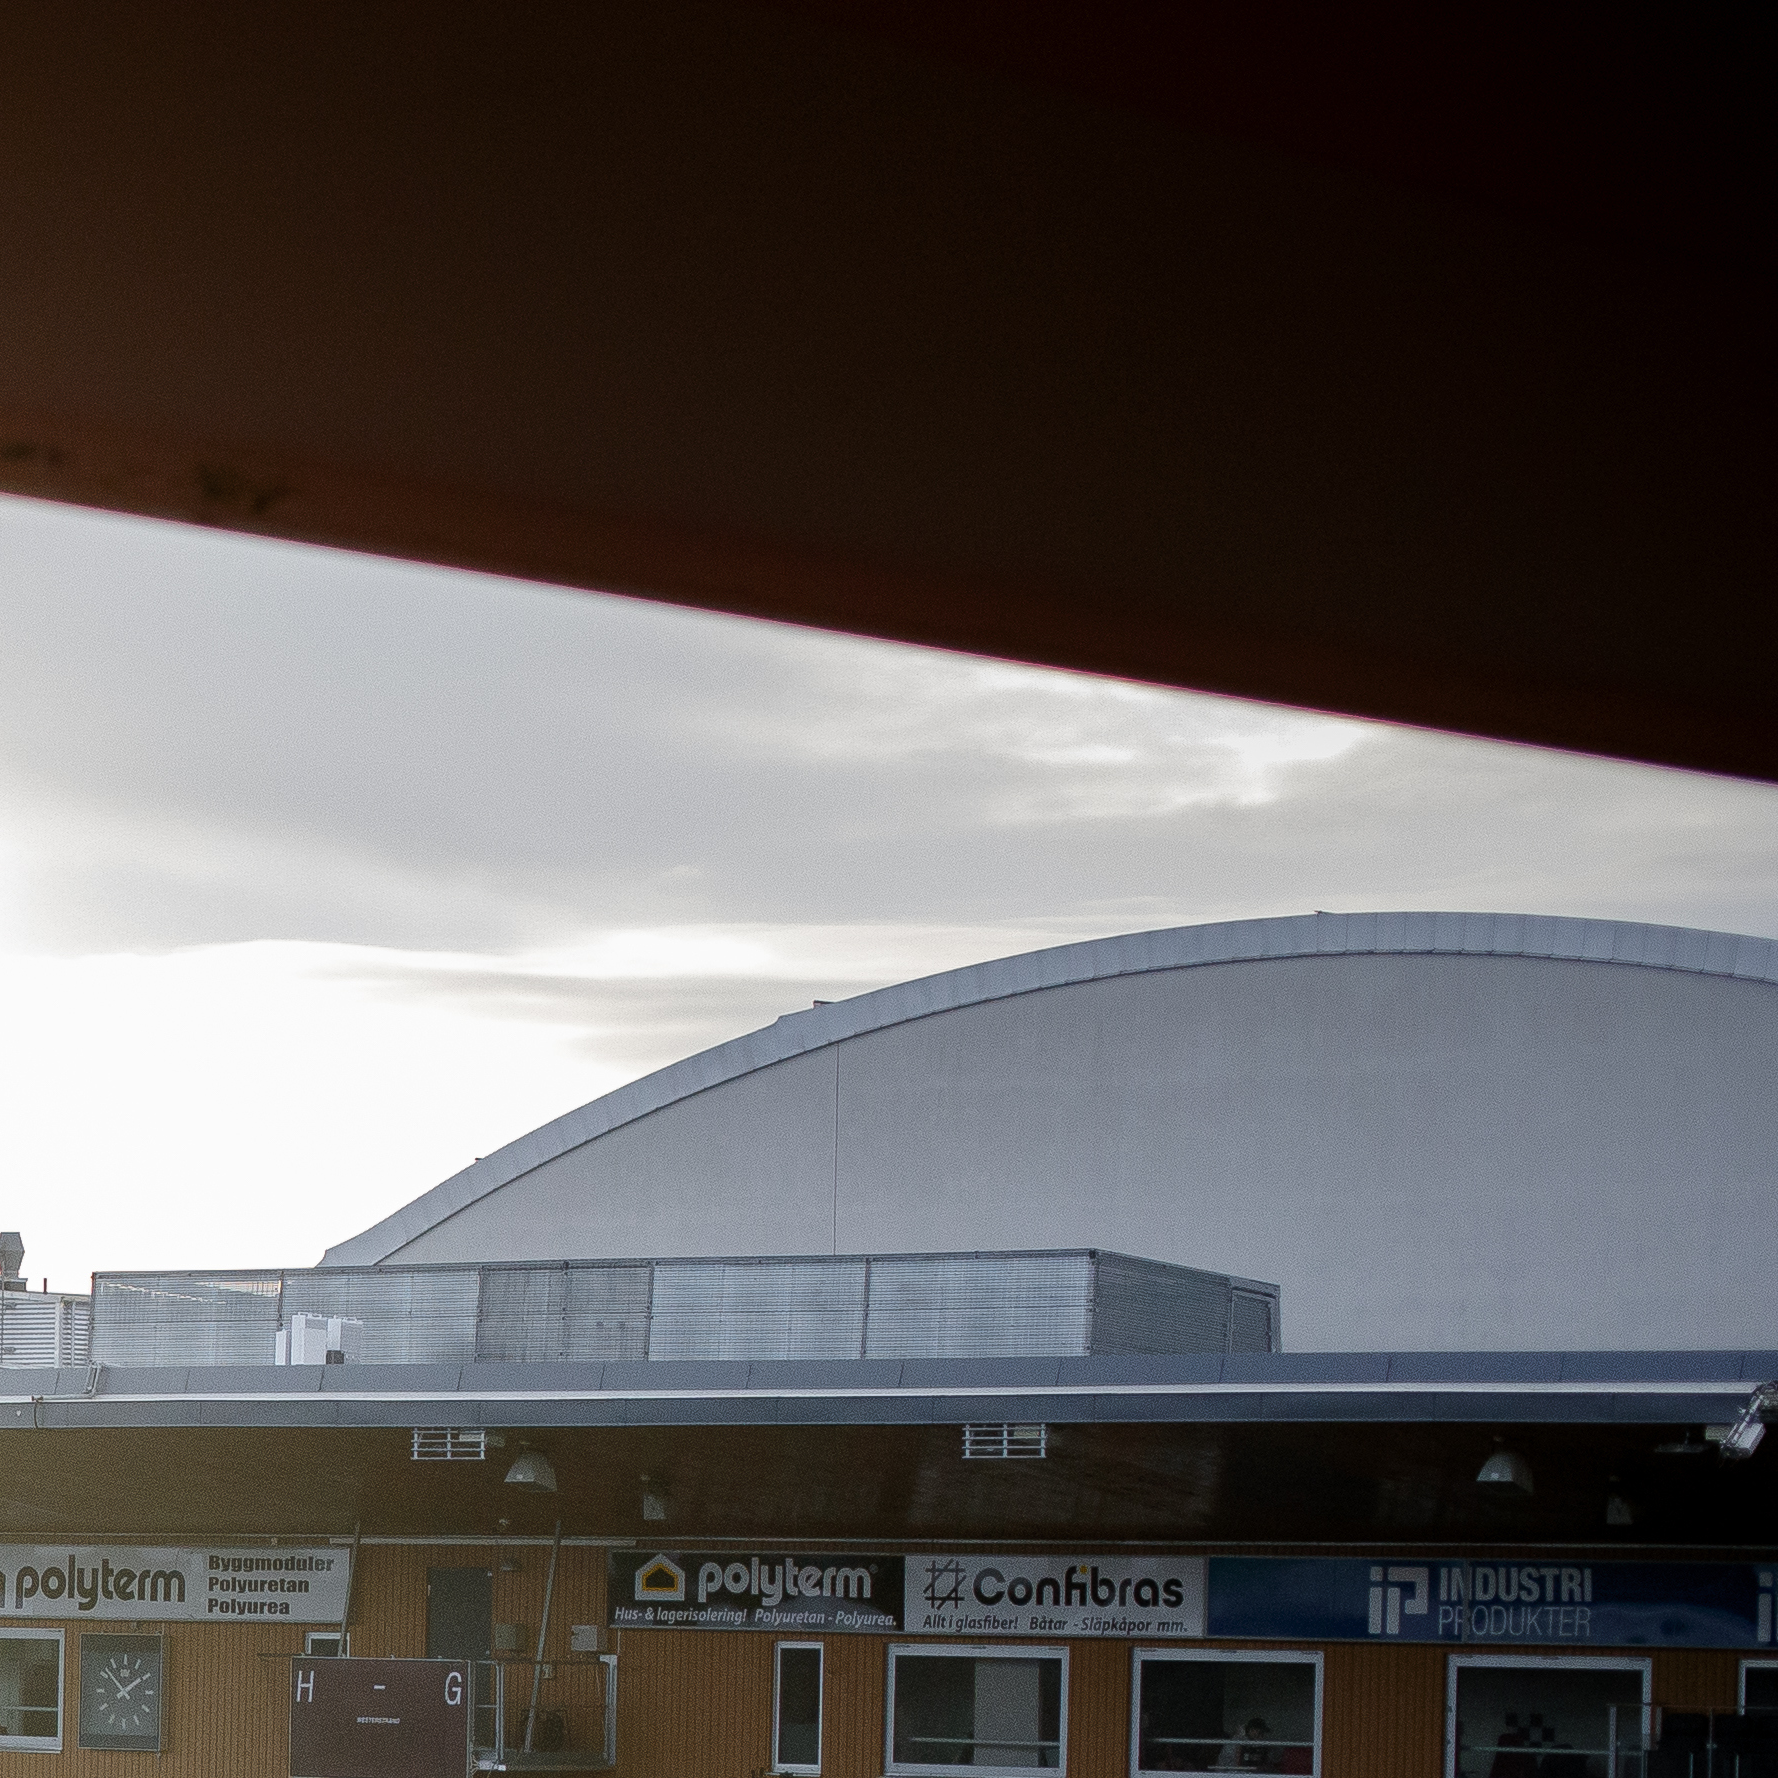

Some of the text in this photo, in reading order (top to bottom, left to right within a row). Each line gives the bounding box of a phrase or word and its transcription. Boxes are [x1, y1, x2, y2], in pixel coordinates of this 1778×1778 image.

[208, 1555, 335, 1573] Byggmoduler
[16, 1554, 185, 1611] polyterm
[208, 1577, 310, 1594] Polyuretan
[697, 1556, 872, 1607] polyterm
[973, 1565, 1183, 1608] Confibras
[1439, 1566, 1593, 1603] INDUSTRI
[208, 1598, 290, 1616] Polyurea
[645, 1607, 655, 1621] &
[754, 1608, 825, 1625] Polyuretan
[923, 1615, 946, 1629] Allt
[956, 1614, 1018, 1632] glasfiber!
[1438, 1604, 1592, 1637] PRODUKTER
[296, 1670, 315, 1703] H
[445, 1671, 462, 1706] G
